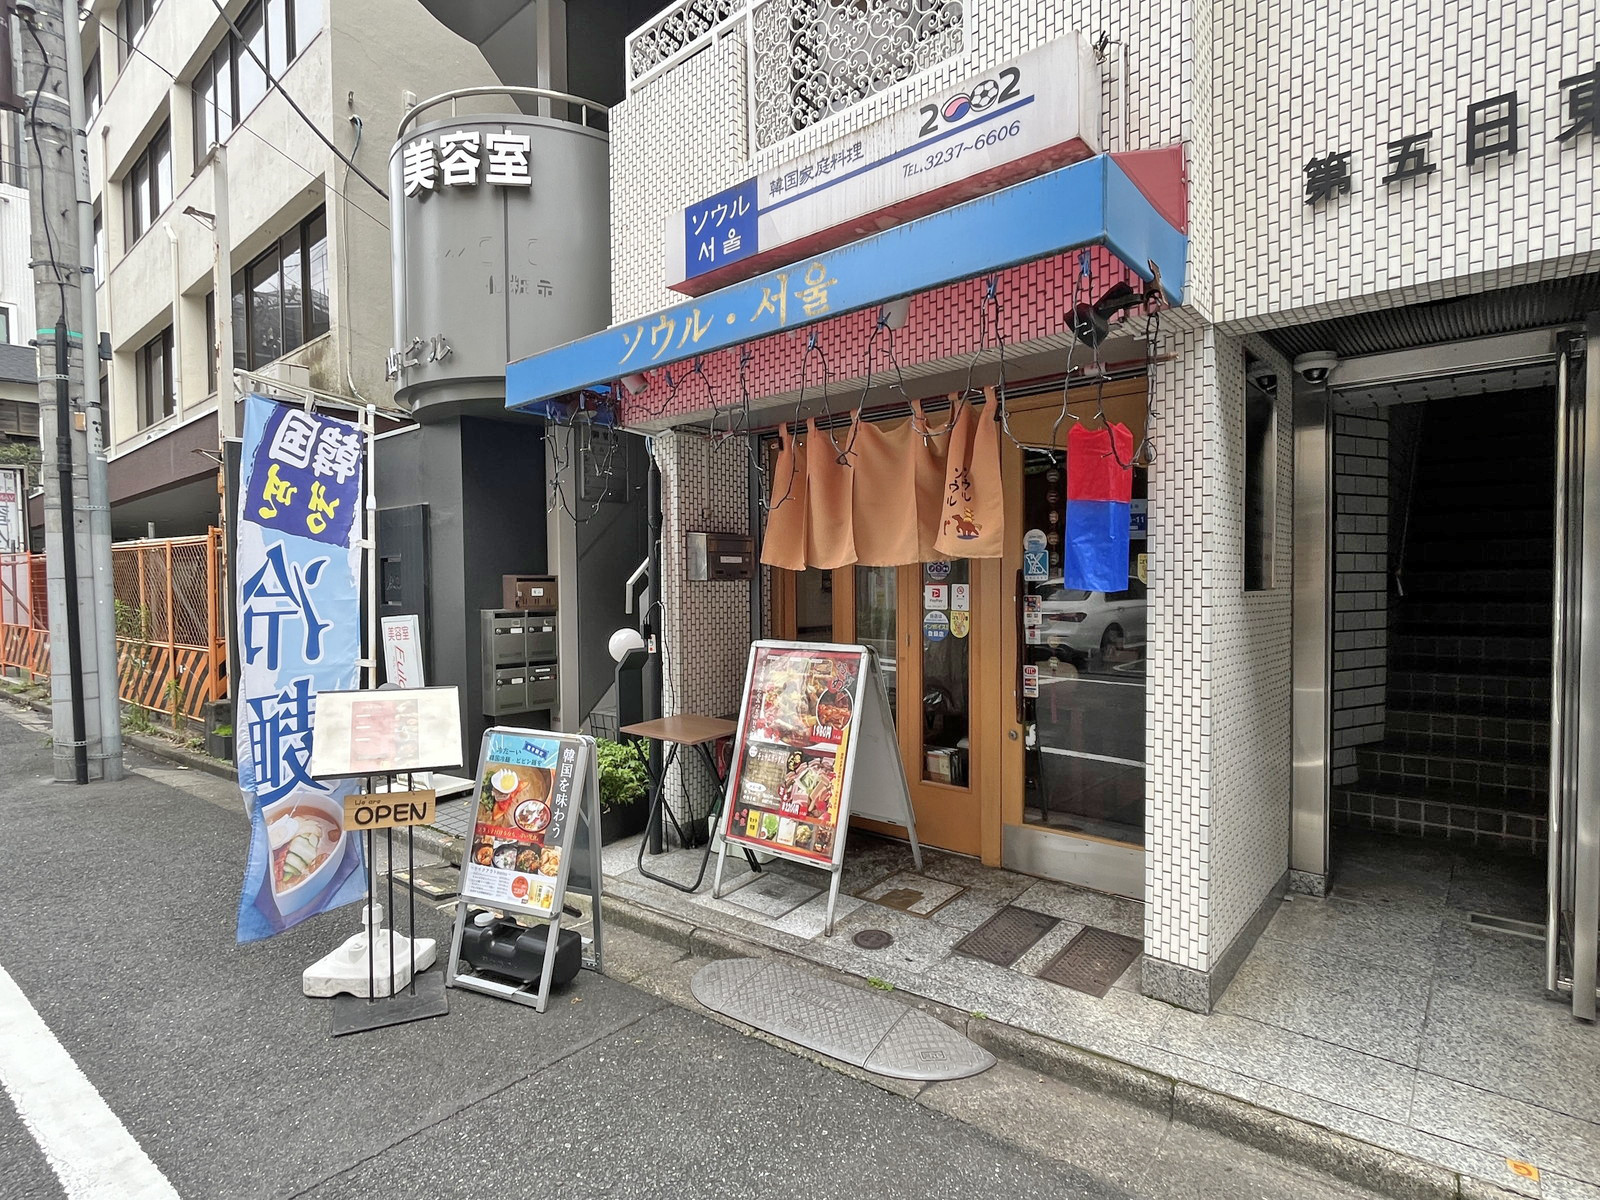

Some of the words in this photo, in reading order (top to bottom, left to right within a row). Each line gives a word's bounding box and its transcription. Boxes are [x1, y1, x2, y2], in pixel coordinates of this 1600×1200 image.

[403, 130, 532, 198] 美容室
[769, 141, 864, 198] 韓国家庭料理
[692, 195, 750, 235] ソウル
[698, 228, 741, 262] 서울
[354, 801, 427, 826] OPEN
[552, 747, 576, 840] 韓国を味わう
